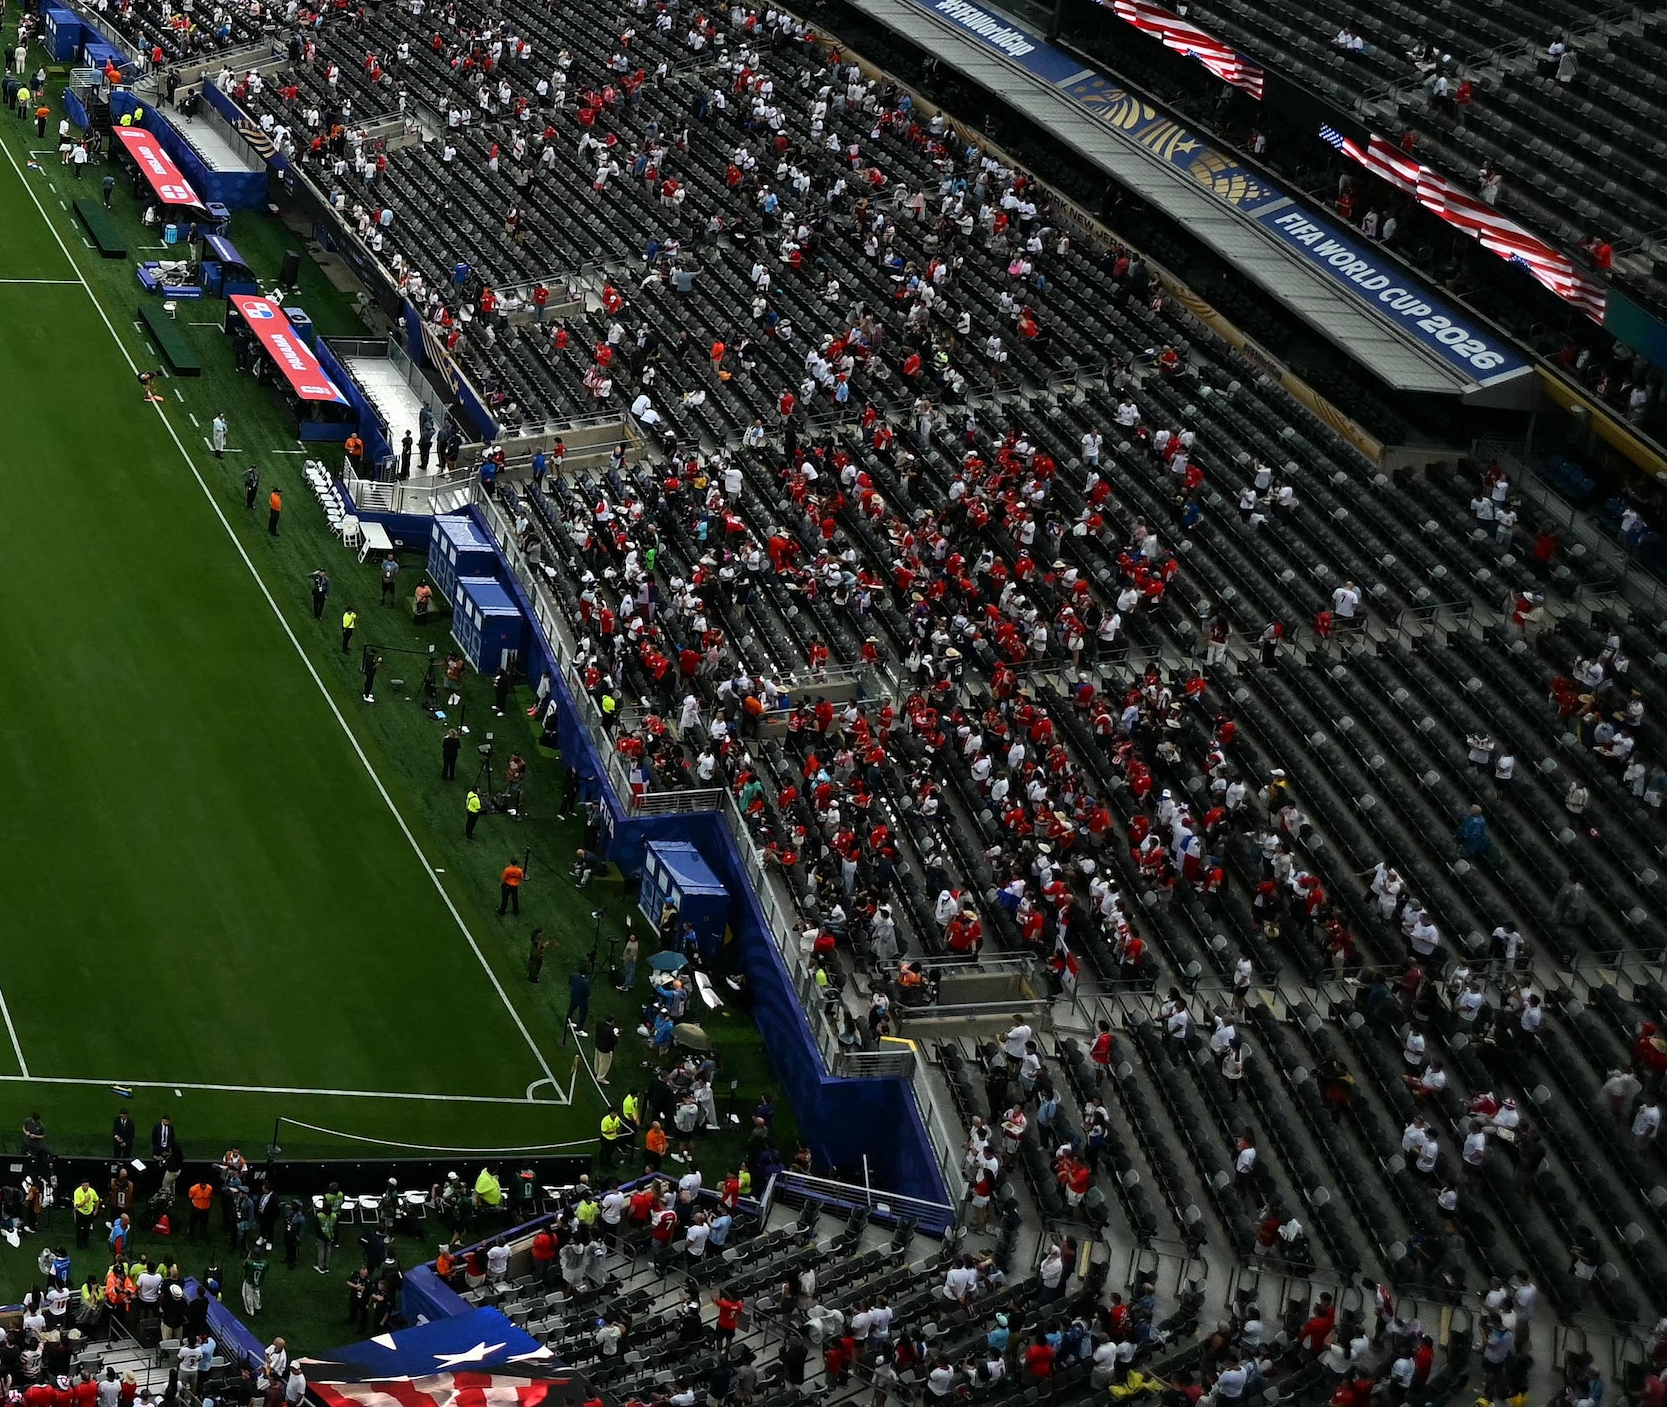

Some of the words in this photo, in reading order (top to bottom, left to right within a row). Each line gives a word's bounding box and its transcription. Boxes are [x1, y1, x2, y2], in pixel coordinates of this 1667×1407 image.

[1069, 207, 1095, 231] NEW
[1274, 211, 1323, 246] FIFA
[1313, 237, 1388, 292] WORLD
[1378, 287, 1432, 319] CUP
[1416, 314, 1505, 371] 2026
[600, 795, 615, 840] FIFA
[665, 1219, 673, 1231] 7
